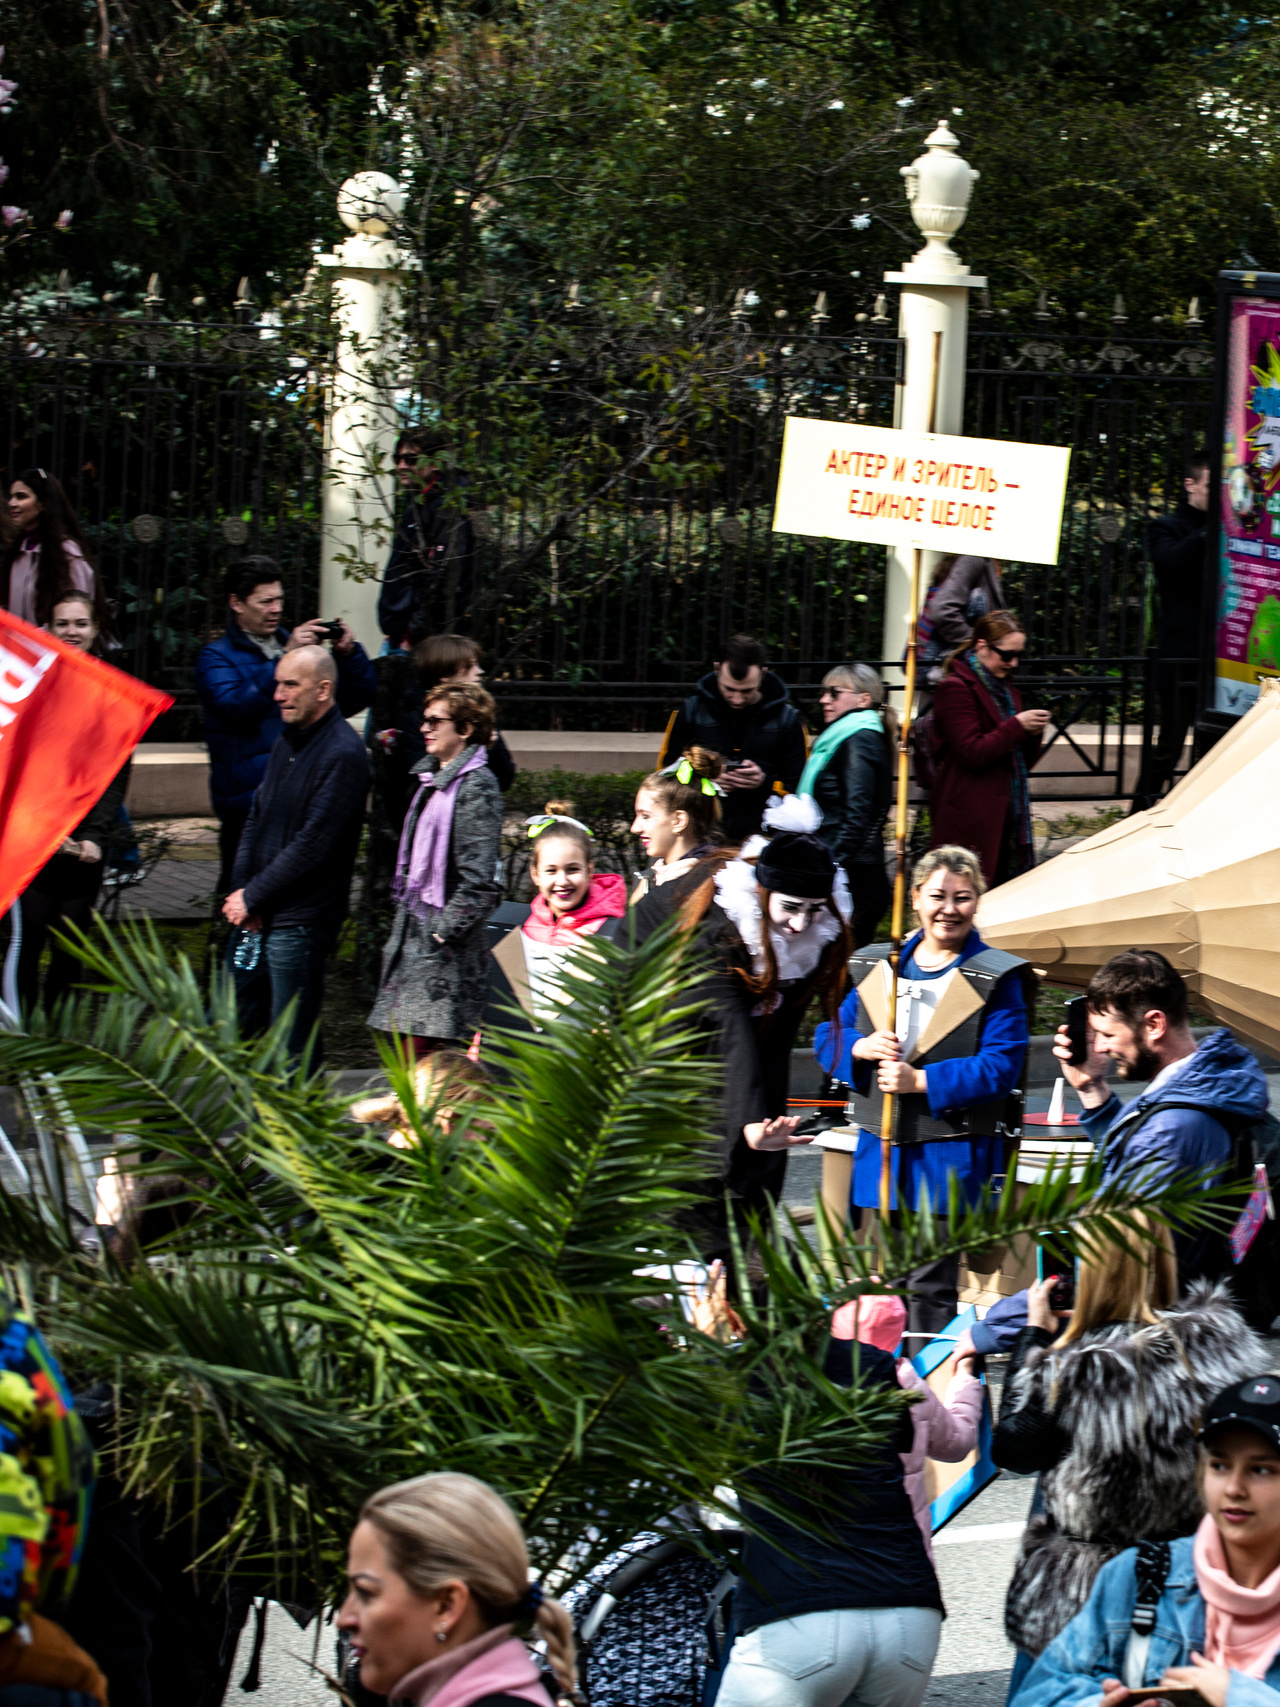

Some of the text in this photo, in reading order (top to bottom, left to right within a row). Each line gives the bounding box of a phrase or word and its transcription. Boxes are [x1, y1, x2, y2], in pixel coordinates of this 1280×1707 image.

[824, 449, 888, 478] АКТЕР
[892, 457, 908, 482] И
[911, 460, 999, 493] ЗРИТЕЛЬ
[848, 489, 997, 531] ЕДИНОЕ ЦЕЛОЕ
